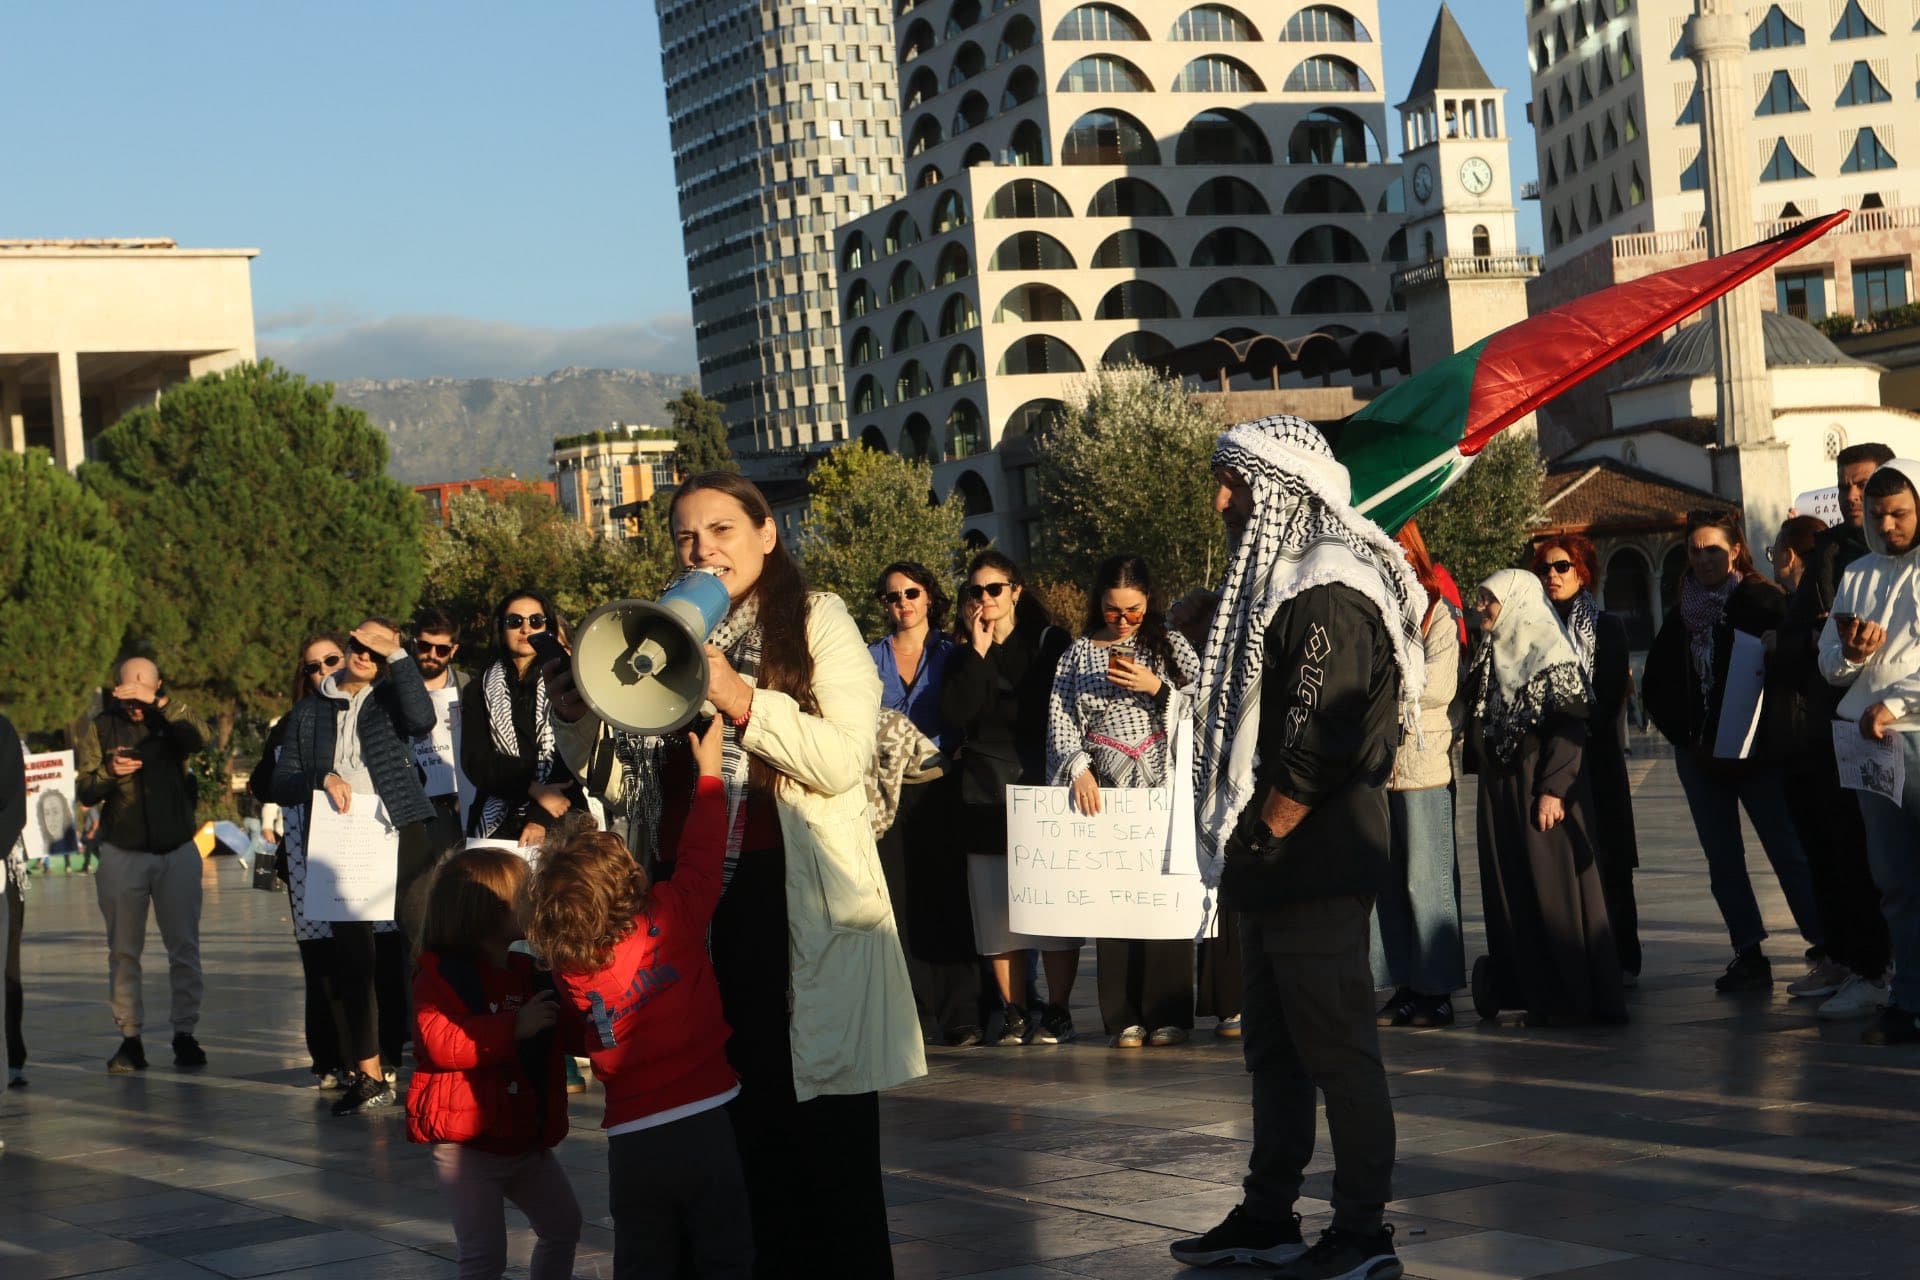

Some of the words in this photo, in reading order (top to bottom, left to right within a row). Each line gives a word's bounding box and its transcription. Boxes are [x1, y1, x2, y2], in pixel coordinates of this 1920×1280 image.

[1814, 504, 1837, 514] GAZ
[415, 743, 450, 755] alestina
[1012, 787, 1070, 815] FRO
[1101, 789, 1136, 815] THE
[1148, 788, 1175, 811] RI
[1037, 820, 1061, 839] TO
[1070, 822, 1097, 839] THE
[1113, 824, 1156, 840] SEA
[1010, 886, 1055, 905] WILL
[1067, 889, 1095, 906] BE
